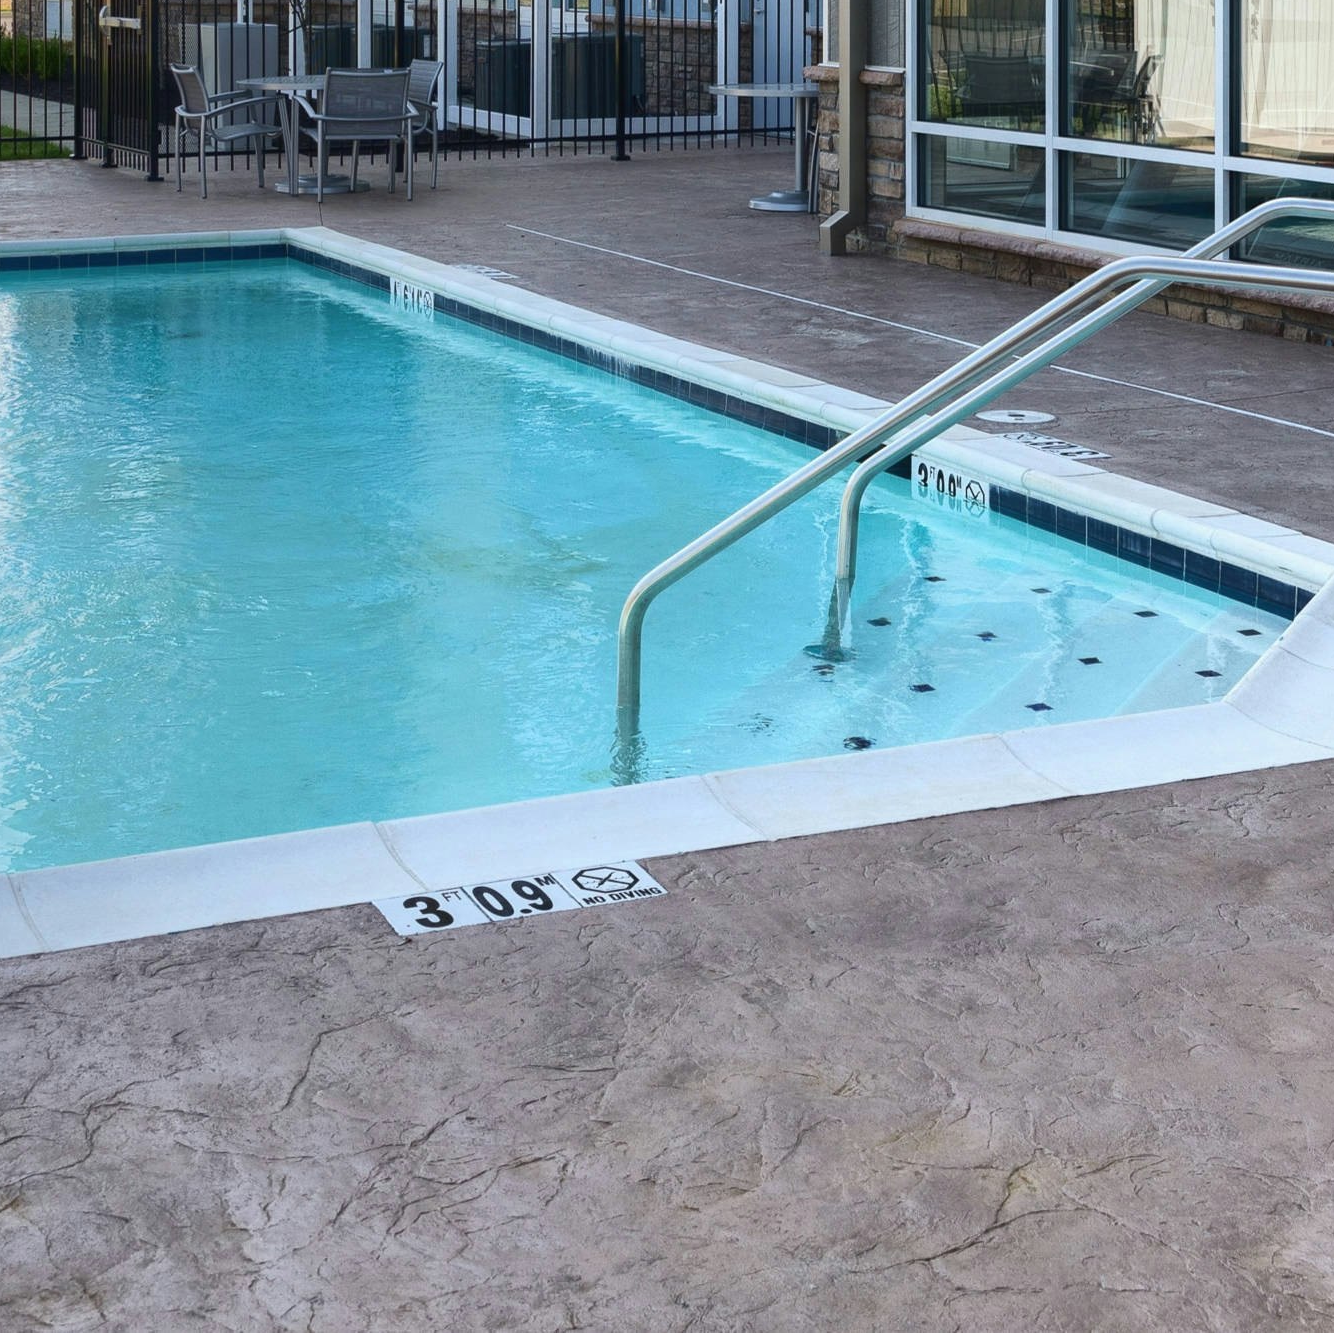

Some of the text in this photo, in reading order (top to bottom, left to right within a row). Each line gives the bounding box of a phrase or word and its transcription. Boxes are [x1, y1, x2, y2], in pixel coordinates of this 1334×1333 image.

[402, 876, 556, 928] 3 FT 0.9 M
[582, 887, 663, 905] NO DIVING
